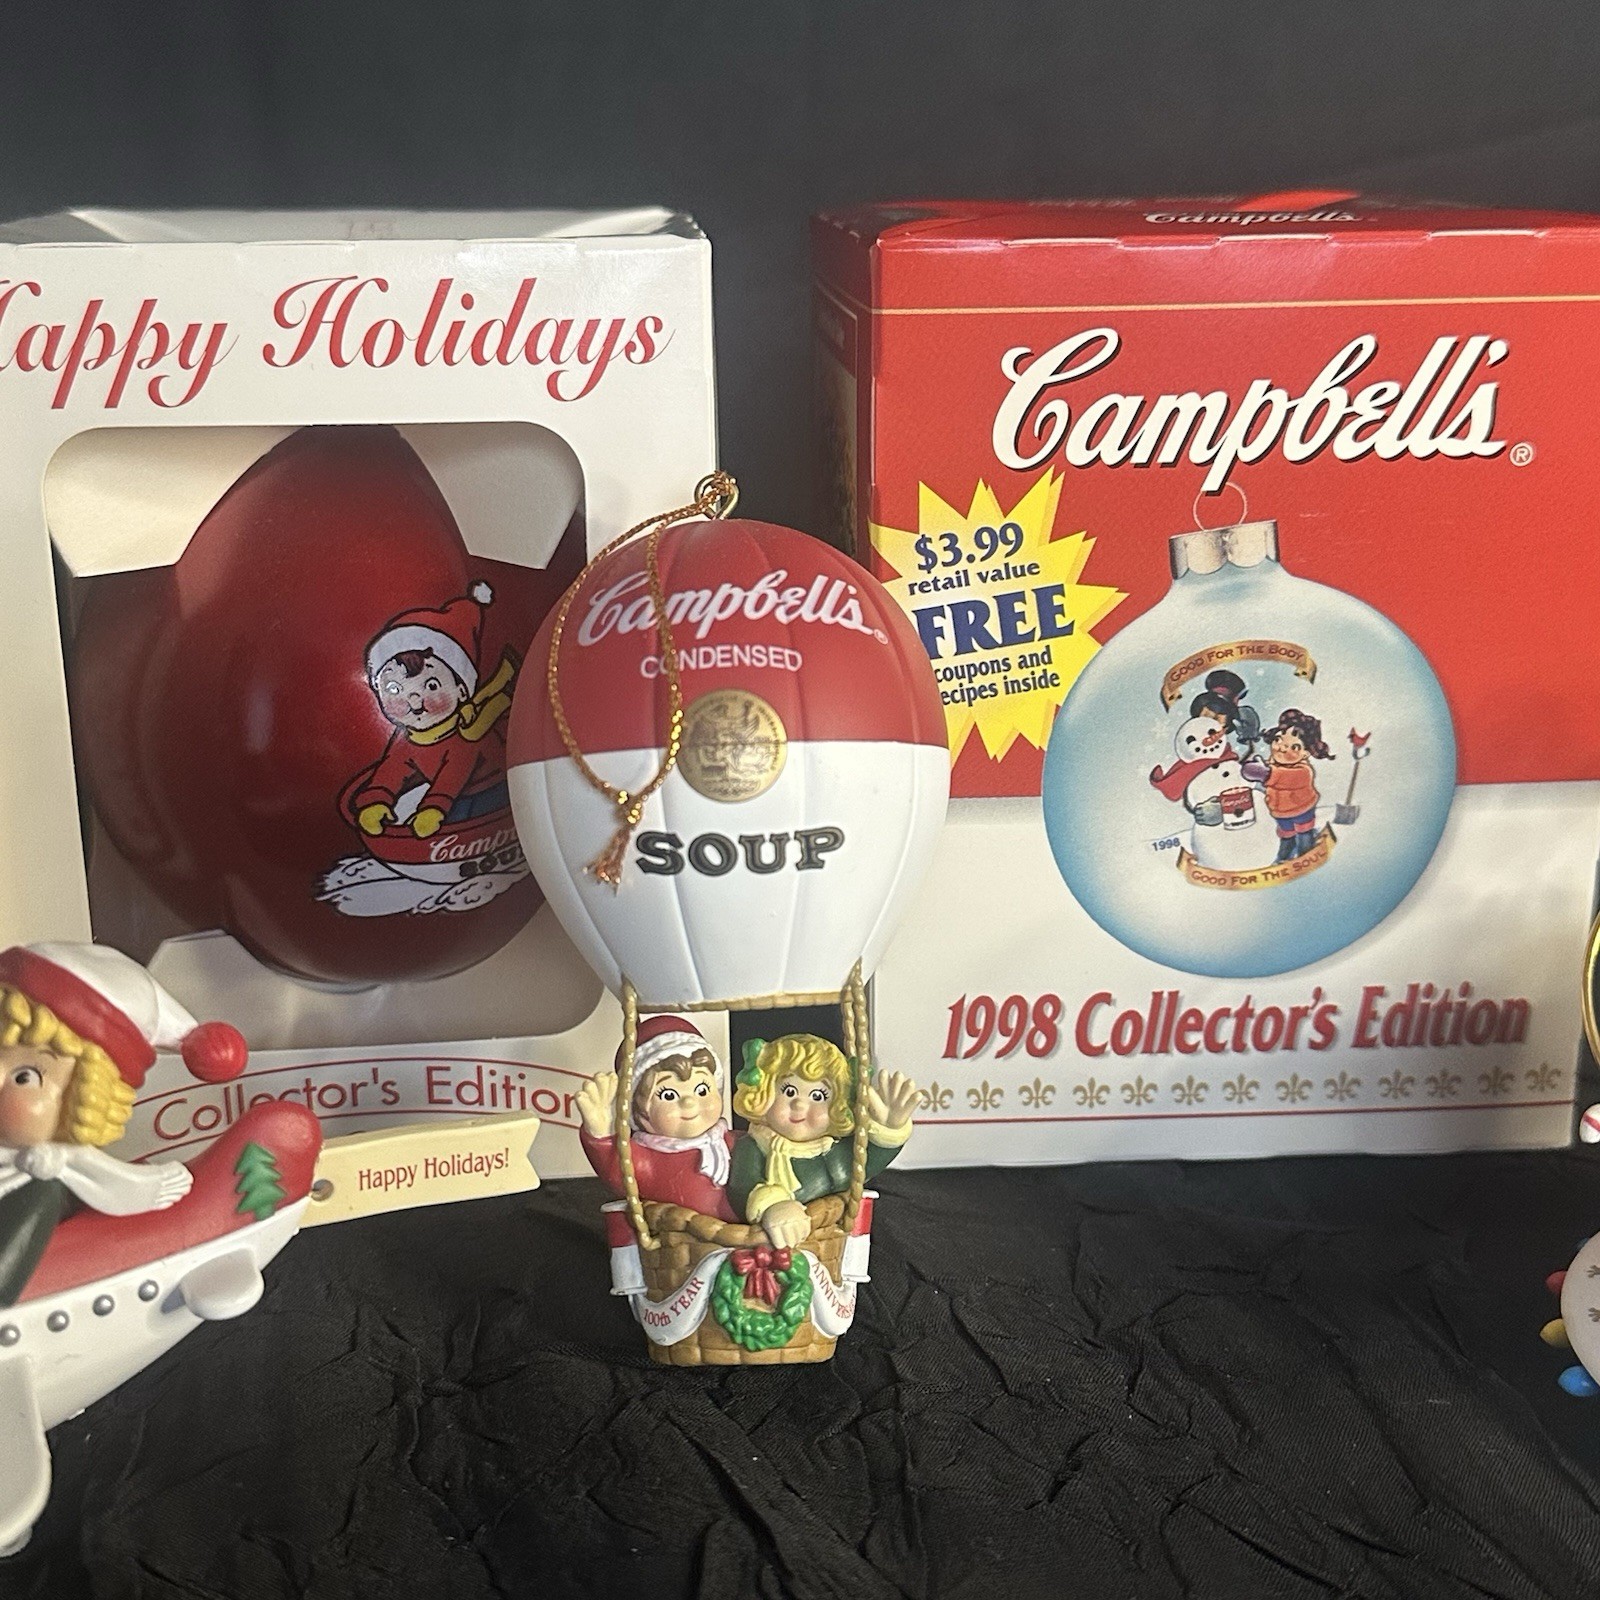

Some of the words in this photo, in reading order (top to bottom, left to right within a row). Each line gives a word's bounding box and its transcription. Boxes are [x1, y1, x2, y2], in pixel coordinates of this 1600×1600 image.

[262, 275, 676, 402] Holidays
[992, 328, 1510, 495] Campbell's
[914, 522, 1024, 574] $3.99
[908, 569, 971, 596] retail
[976, 560, 1041, 584] value
[577, 569, 874, 647] Campbell's
[912, 583, 1075, 661] FREE
[934, 655, 1012, 684] coupons
[1017, 645, 1053, 671] and
[940, 681, 999, 707] ecipes
[1004, 668, 1060, 696] inside
[1170, 657, 1205, 683] GOOD
[1207, 648, 1234, 664] FOR
[1236, 645, 1265, 656] THE
[1268, 644, 1304, 661] BODY
[635, 825, 845, 877] SOUP
[1151, 837, 1181, 852] 1998
[1191, 870, 1227, 886] GOOD
[1231, 875, 1257, 886] FOR
[1261, 869, 1290, 881] THE
[1292, 850, 1327, 873] SOUL
[941, 993, 1063, 1061] 1998
[1075, 986, 1340, 1057] Collector's
[1351, 981, 1531, 1049] Edition
[358, 1164, 418, 1192] Happy
[424, 1147, 510, 1178] Holidays!
[643, 1308, 672, 1327] 100th
[669, 1276, 705, 1317] YEAR
